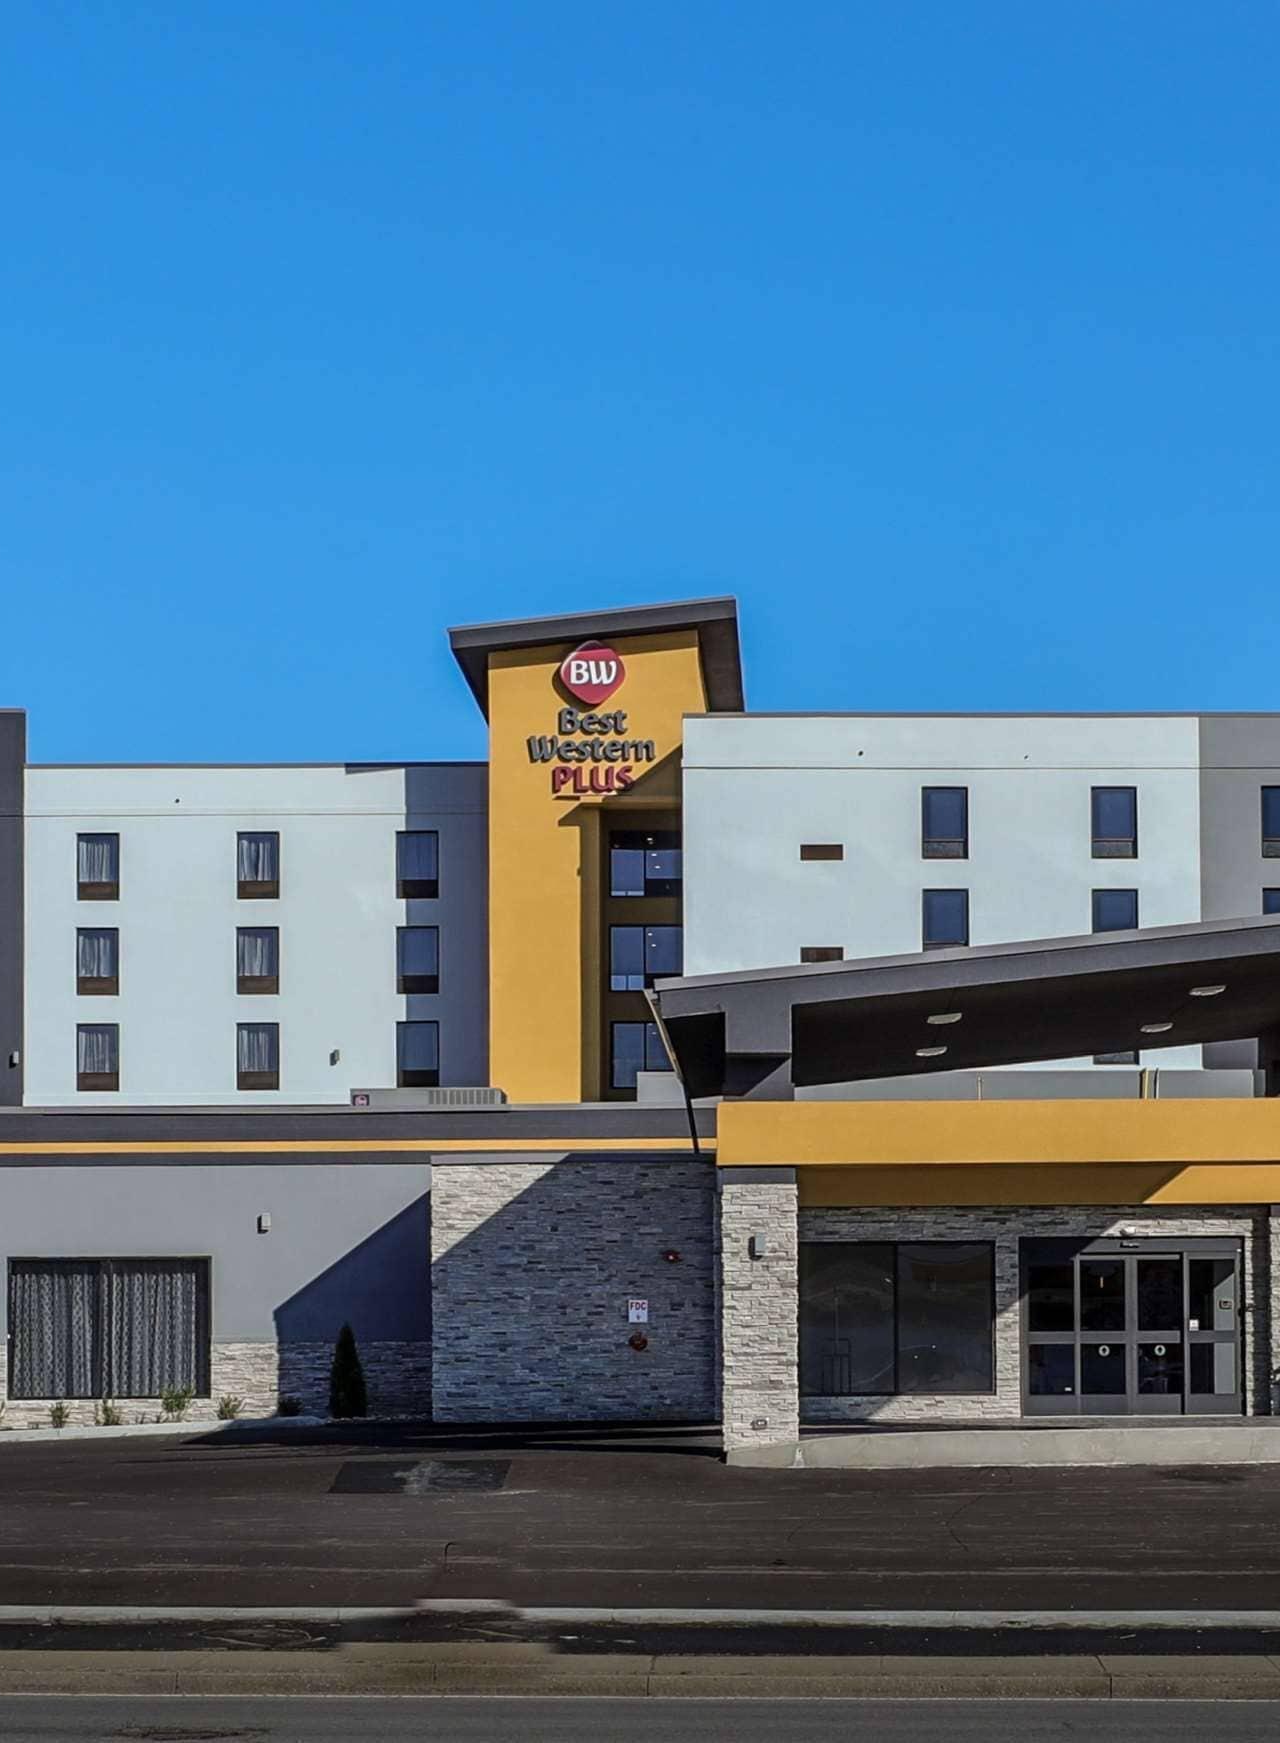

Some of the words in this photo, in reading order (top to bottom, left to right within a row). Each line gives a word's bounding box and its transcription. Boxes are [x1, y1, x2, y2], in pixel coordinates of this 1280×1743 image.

[570, 660, 617, 685] BW
[560, 708, 627, 734] Best
[528, 736, 655, 763] Western
[553, 766, 633, 793] PLUS
[630, 1302, 647, 1311] FDC
